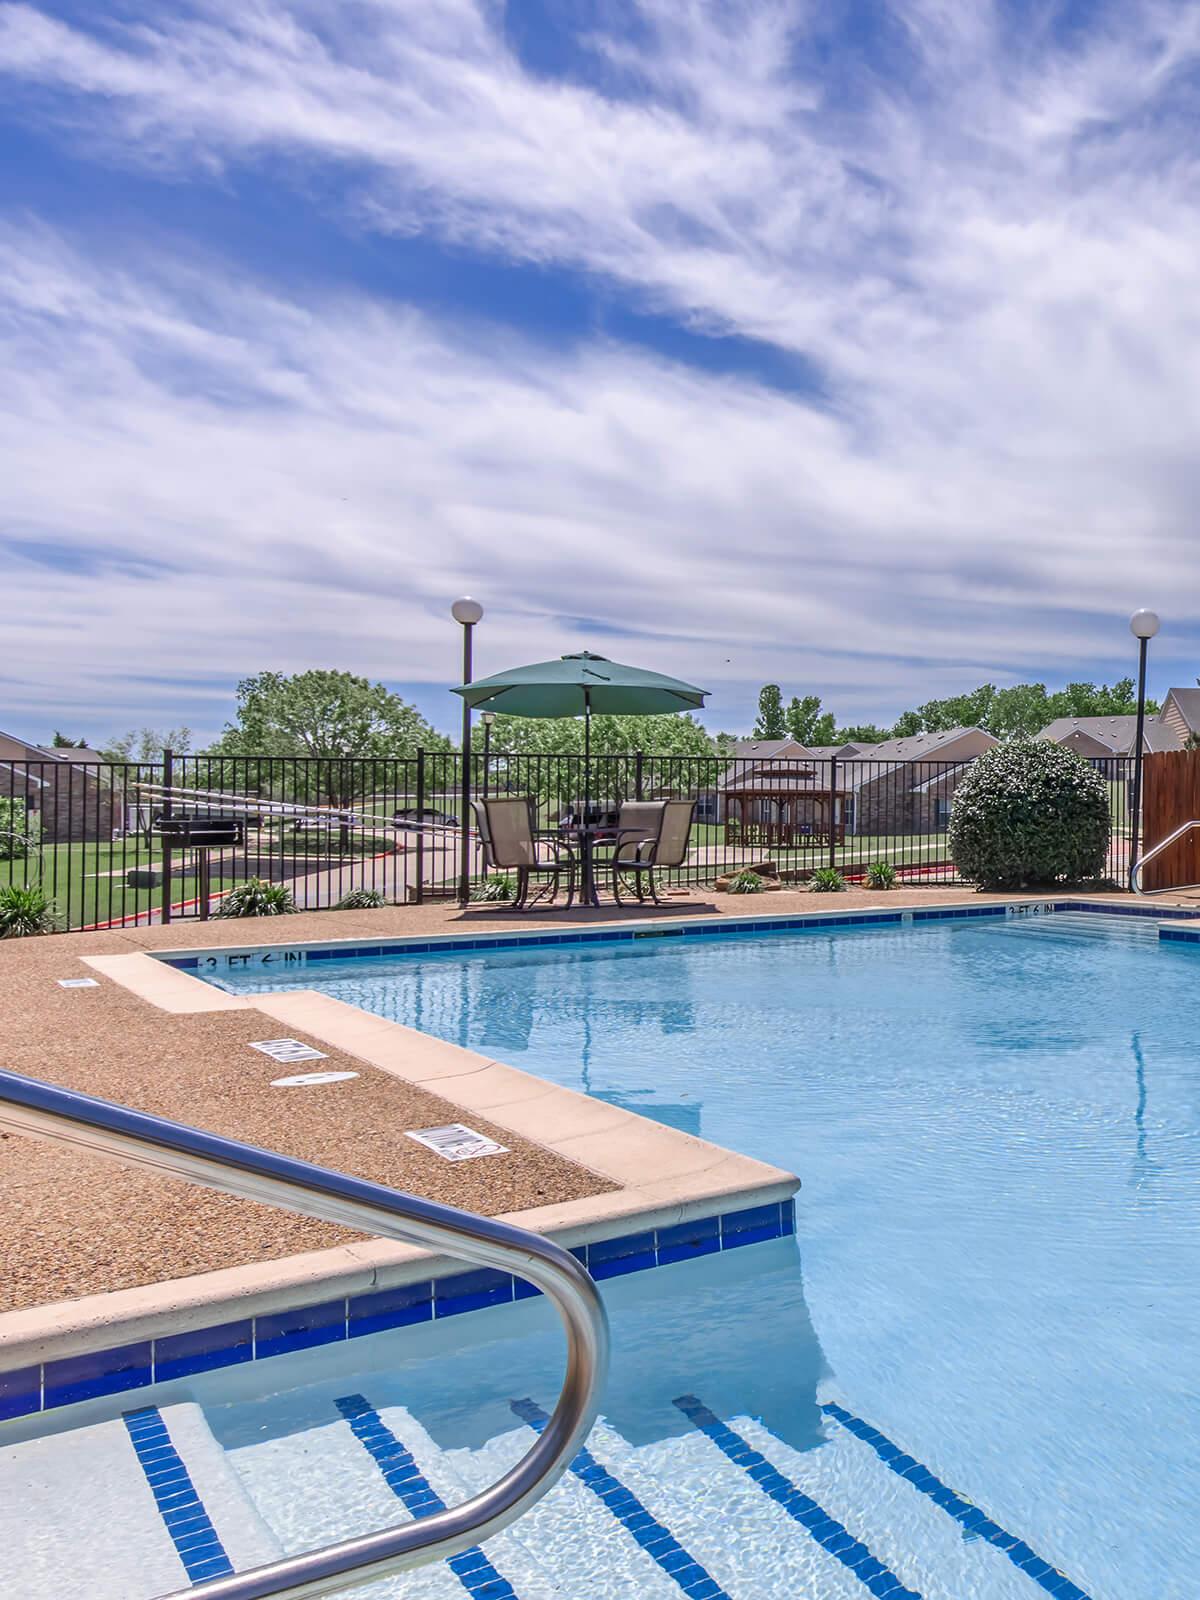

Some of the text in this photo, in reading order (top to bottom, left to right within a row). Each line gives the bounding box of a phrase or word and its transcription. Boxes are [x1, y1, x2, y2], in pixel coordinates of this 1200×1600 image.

[1044, 903, 1056, 912] IN
[228, 954, 251, 965] FT
[285, 952, 301, 962] IN
